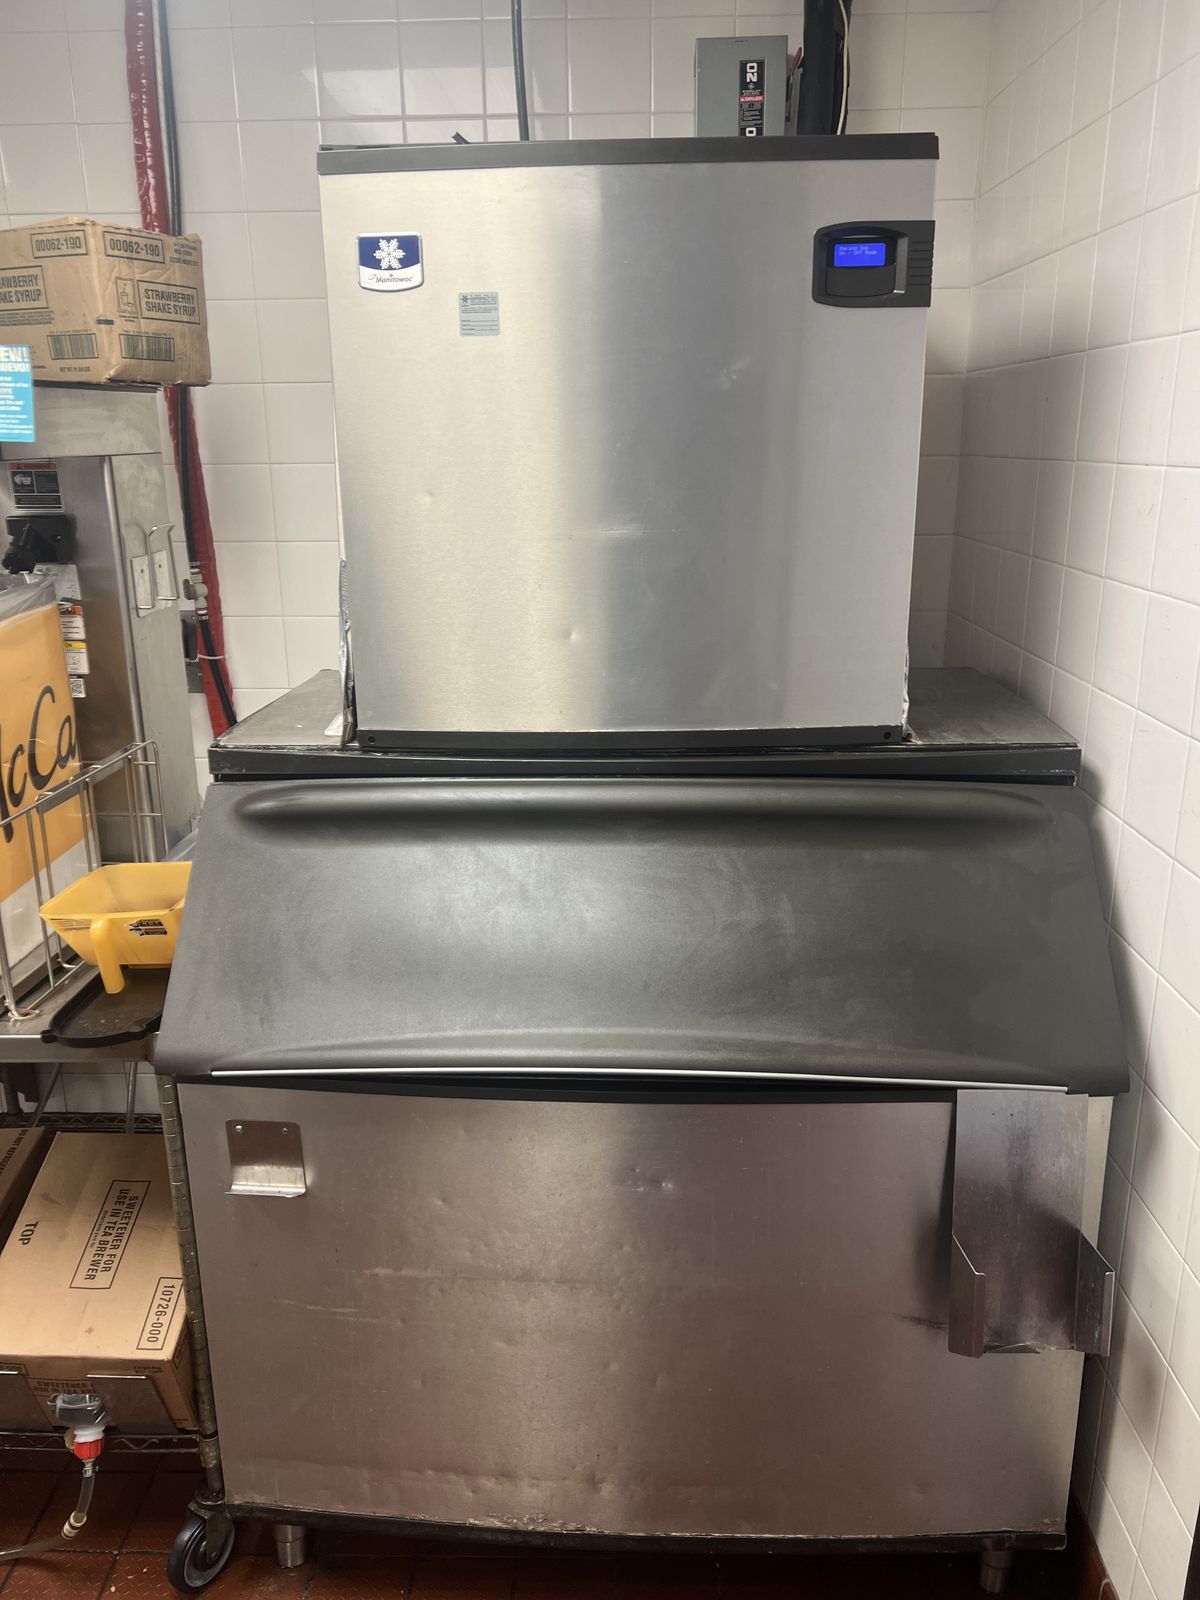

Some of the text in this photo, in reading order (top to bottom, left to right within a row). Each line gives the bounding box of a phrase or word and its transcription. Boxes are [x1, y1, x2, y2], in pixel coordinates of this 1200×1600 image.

[746, 62, 758, 82] ON
[35, 236, 82, 252] 00062-190
[109, 238, 160, 257] 00062-190
[0, 274, 38, 289] AWBERRY
[372, 273, 413, 283] Manitowoc
[14, 288, 42, 303] SYRUP
[144, 288, 195, 305] STRAWBERRY
[145, 301, 196, 317] SHAKE SYRUP
[0, 347, 28, 361] EW!
[0, 363, 29, 372] UEVO!
[114, 1188, 131, 1206] USE
[109, 1208, 123, 1218] IN
[18, 1221, 39, 1245] TOP
[100, 1195, 139, 1273] SWEETENER FOR
[101, 1220, 118, 1238] TEA
[84, 1240, 109, 1281] BREWER
[147, 1284, 175, 1343] 10726-000
